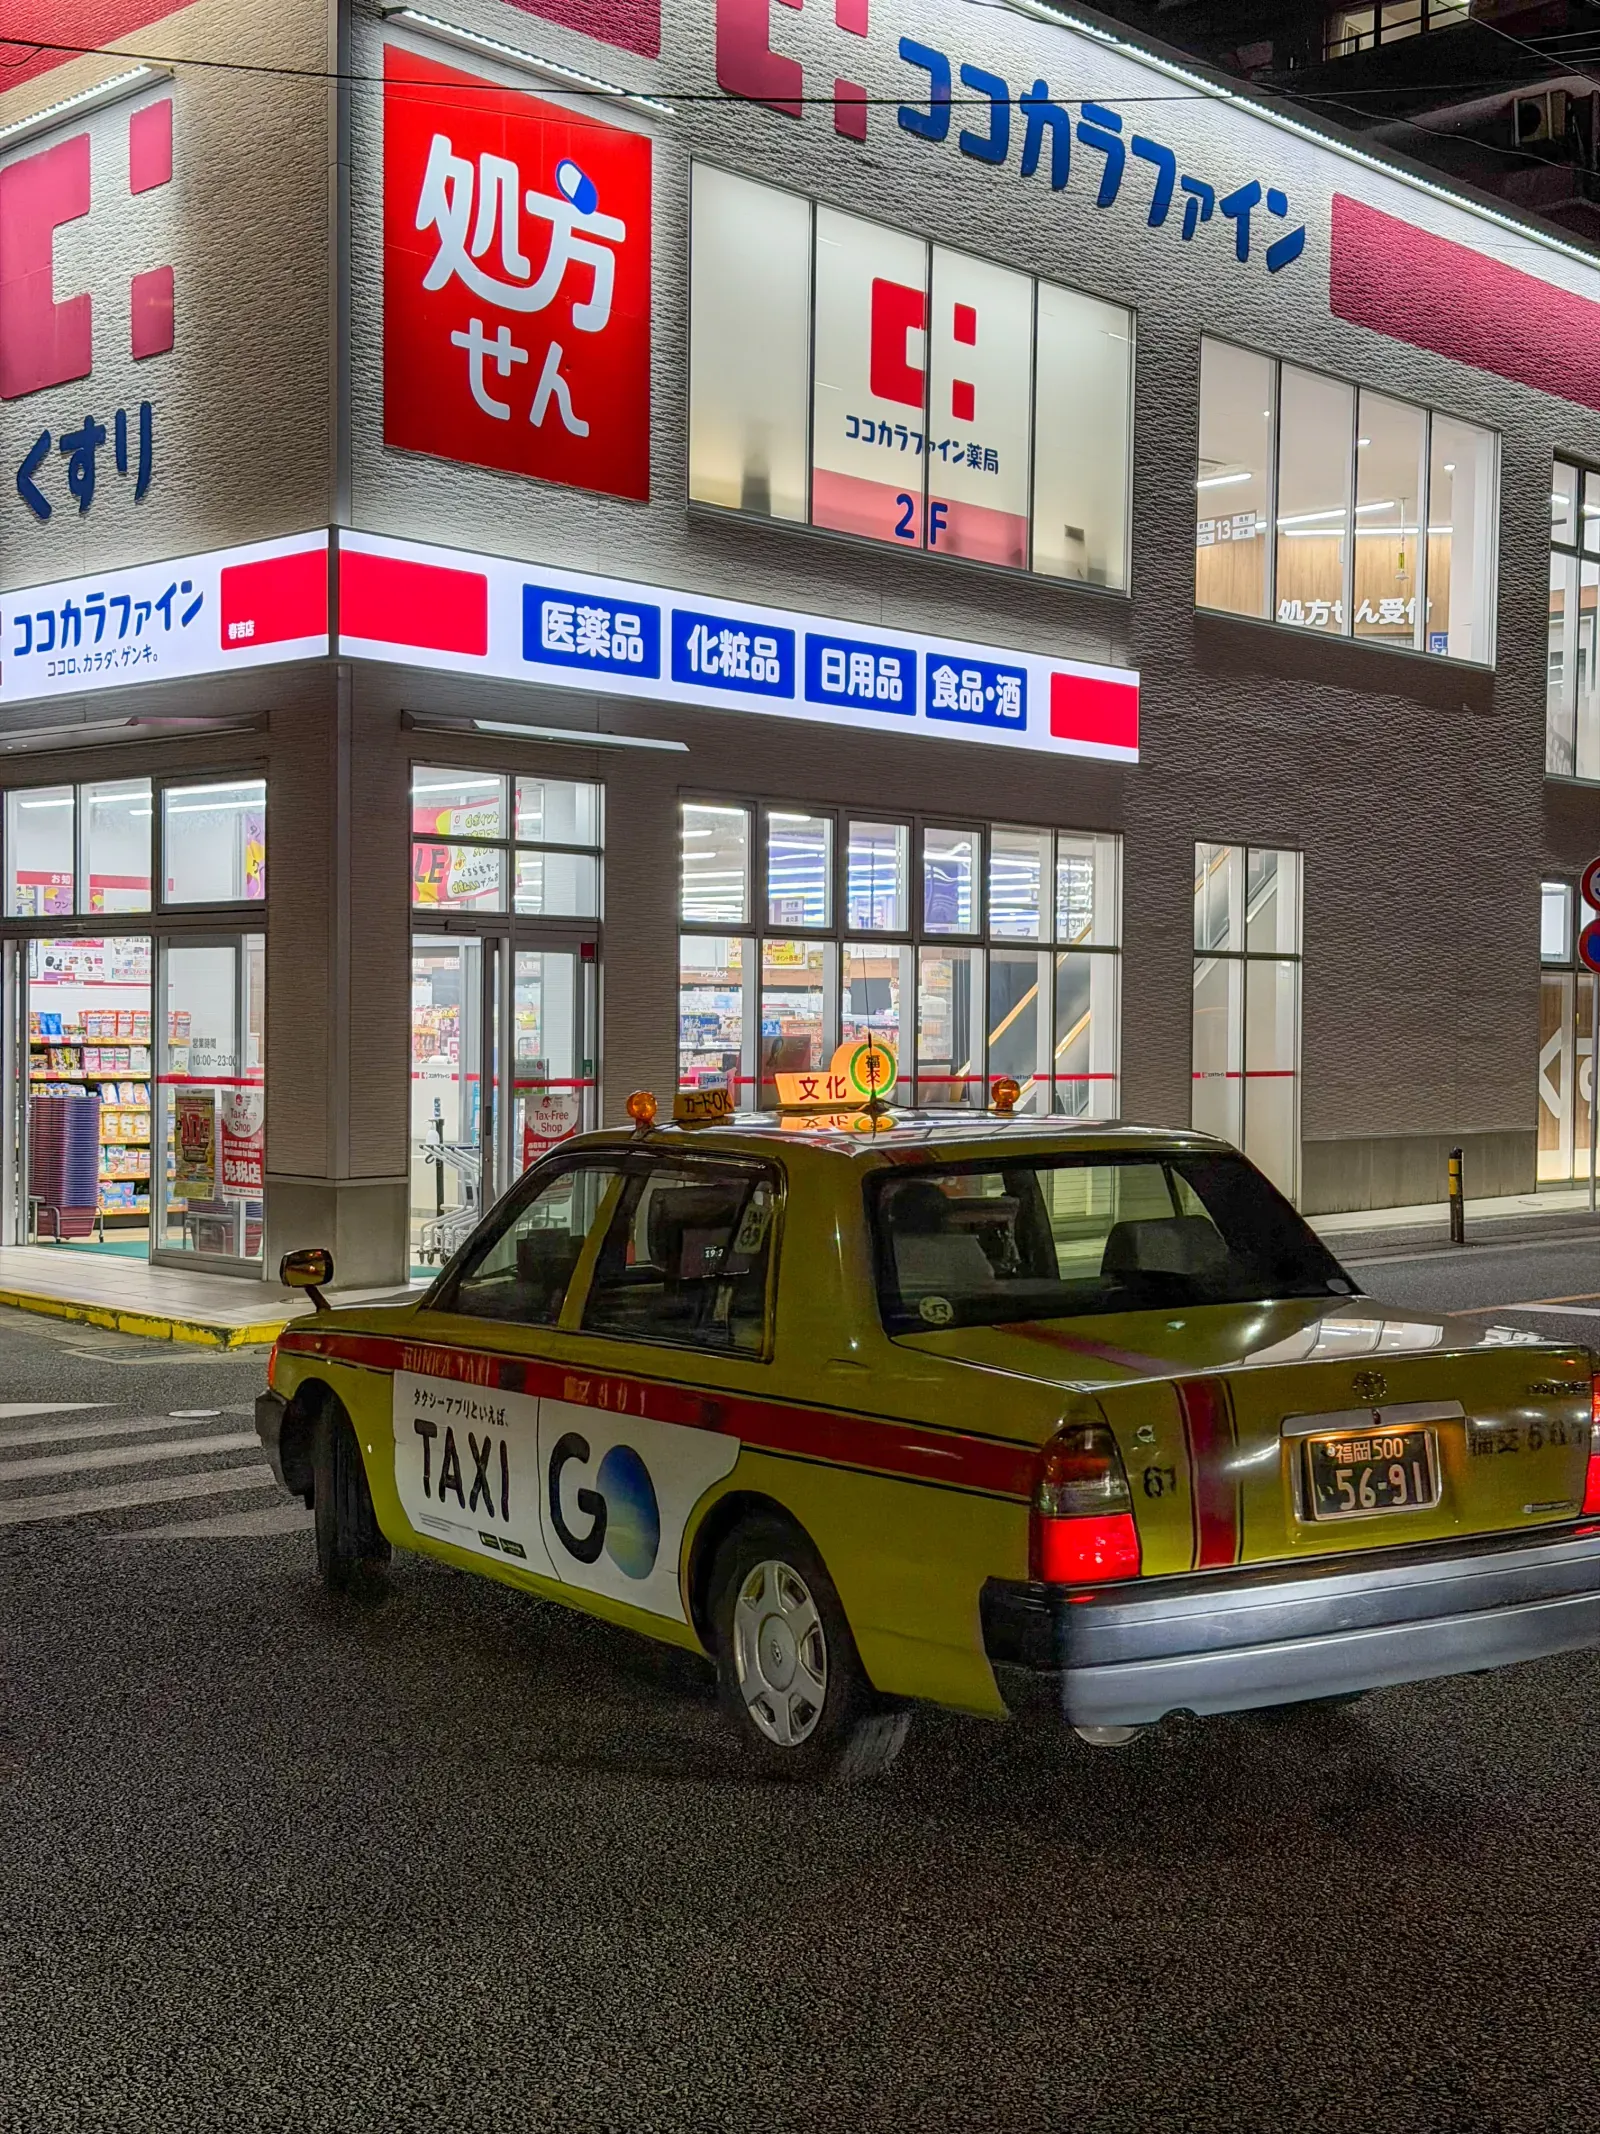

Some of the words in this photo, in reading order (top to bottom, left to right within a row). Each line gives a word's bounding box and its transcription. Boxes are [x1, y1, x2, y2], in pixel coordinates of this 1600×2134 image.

[899, 36, 1305, 272] ココカラファイン
[416, 133, 625, 333] 処方
[451, 317, 590, 438] せん
[16, 400, 153, 520] くすり
[845, 414, 999, 475] ココカラファイン薬局
[1216, 520, 1232, 541] 13
[13, 579, 204, 656] ココカラファイン
[541, 601, 644, 662] 医薬品
[687, 624, 780, 684] 化粧品
[820, 647, 903, 701] 日用品
[535, 1110, 569, 1121] Tax-Free
[799, 1075, 847, 1101] 文化
[541, 1122, 562, 1134] Shop
[224, 1160, 262, 1185] 免税店
[413, 1418, 510, 1523] TAXI
[1335, 1440, 1371, 1463] 福岡
[1372, 1438, 1404, 1459] 500
[1335, 1461, 1424, 1511] 56-91
